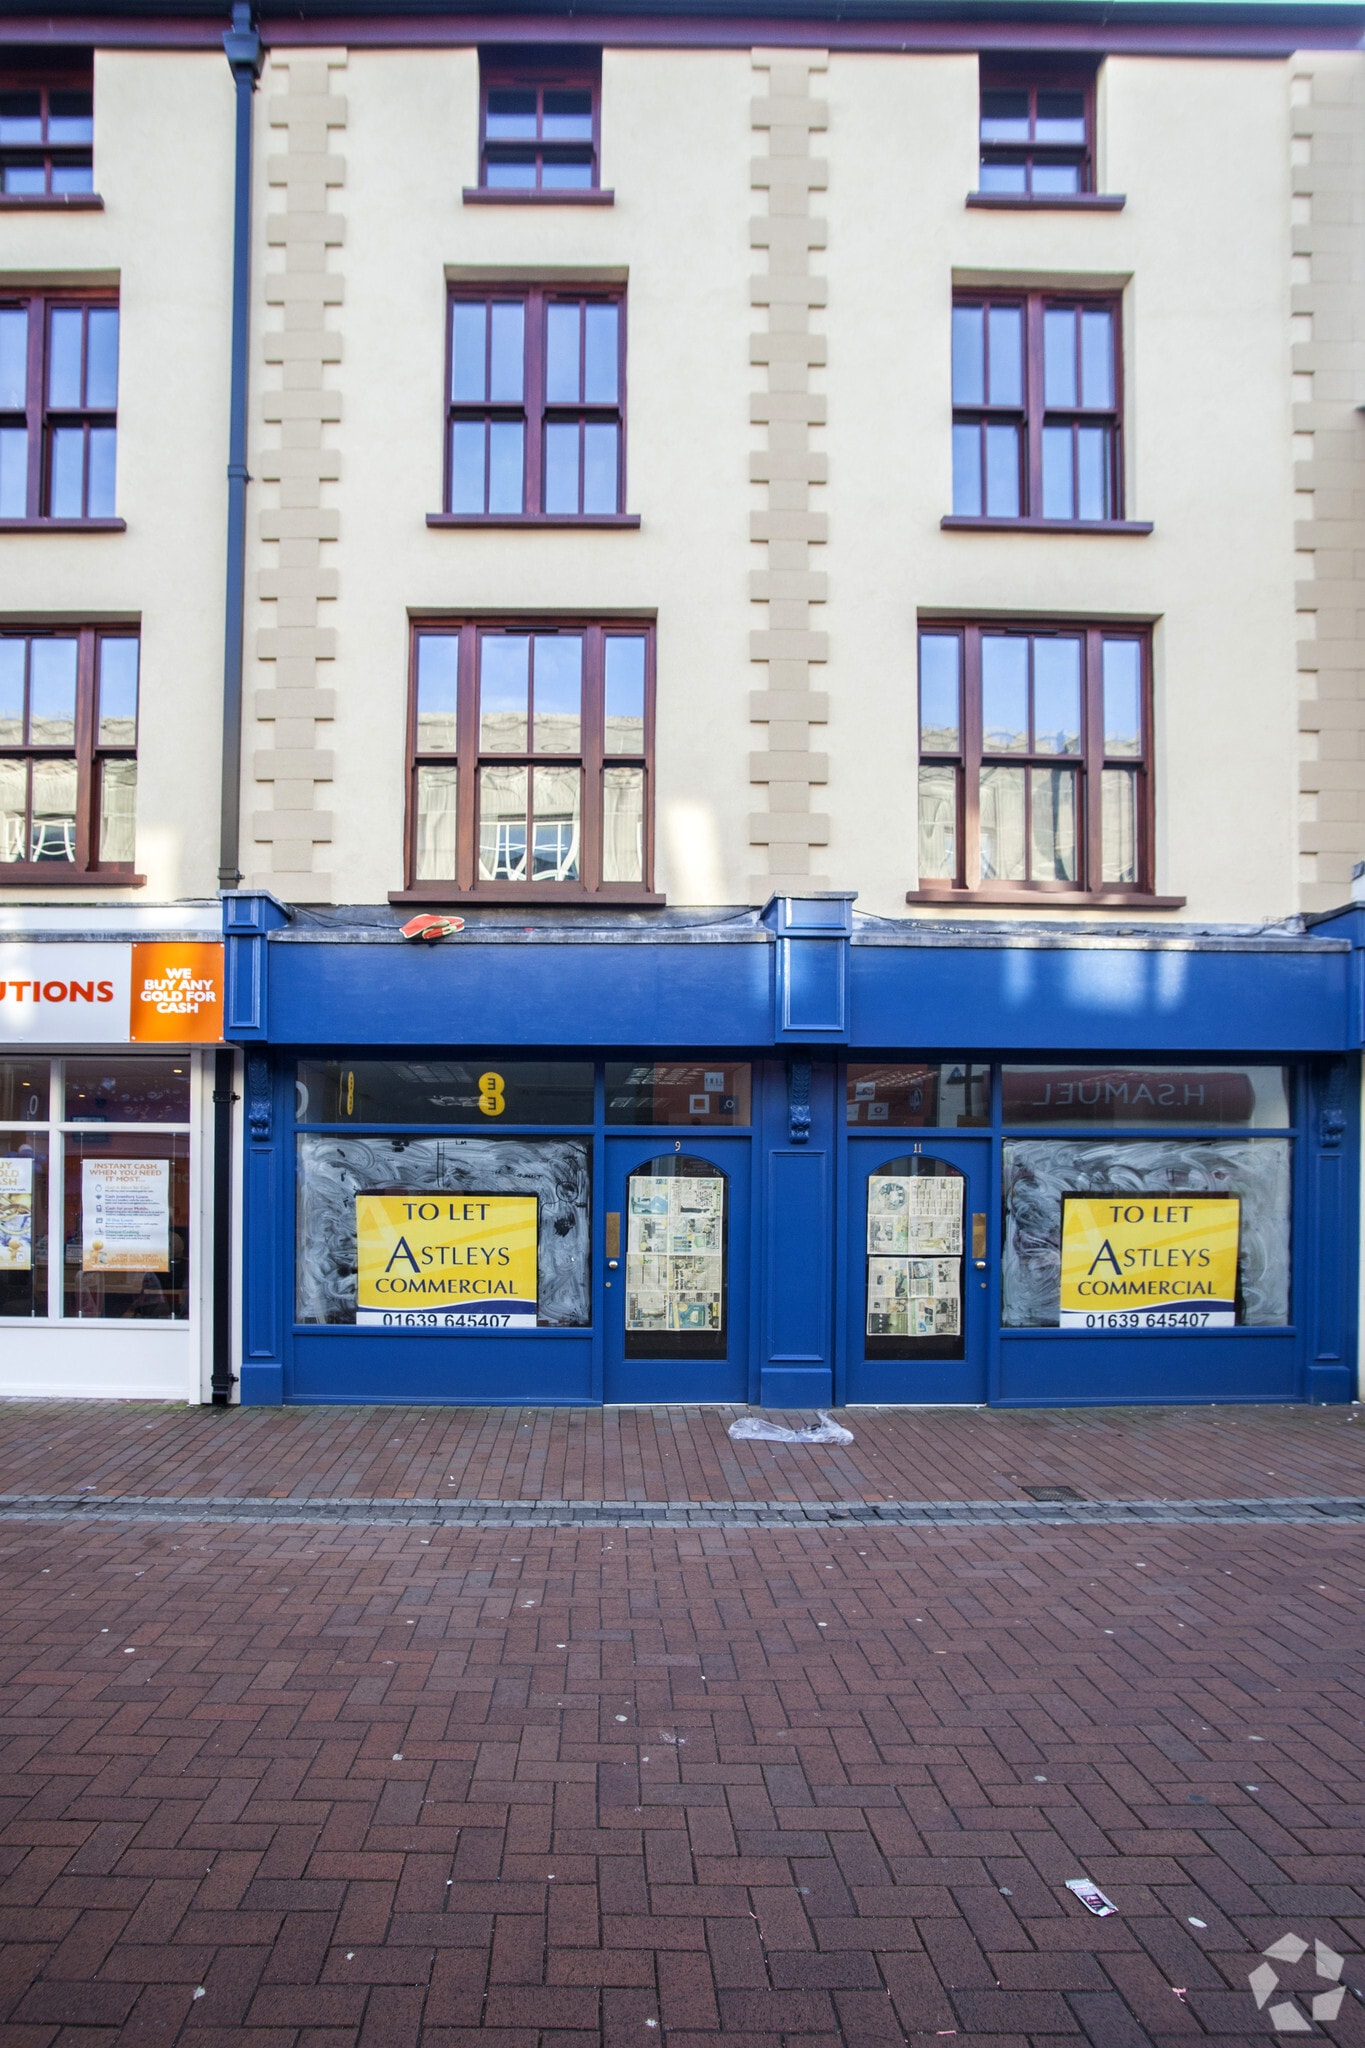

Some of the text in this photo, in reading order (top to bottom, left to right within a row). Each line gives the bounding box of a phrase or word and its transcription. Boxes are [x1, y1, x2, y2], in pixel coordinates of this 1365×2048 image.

[165, 967, 192, 979] WE
[144, 979, 214, 991] BUY ANY
[140, 991, 216, 1002] GOLD FOR
[156, 1003, 199, 1013] CASH
[674, 1141, 681, 1152] 9
[913, 1143, 922, 1153] 11
[0, 1177, 17, 1186] SH
[402, 1203, 490, 1221] TO LET
[1109, 1206, 1193, 1223] TO LET
[375, 1278, 518, 1294] COMMERCIAL
[1077, 1281, 1217, 1296] COMMERCIAL
[383, 1313, 511, 1328] 01639 645407
[1086, 1313, 1210, 1328] 01639 645407
